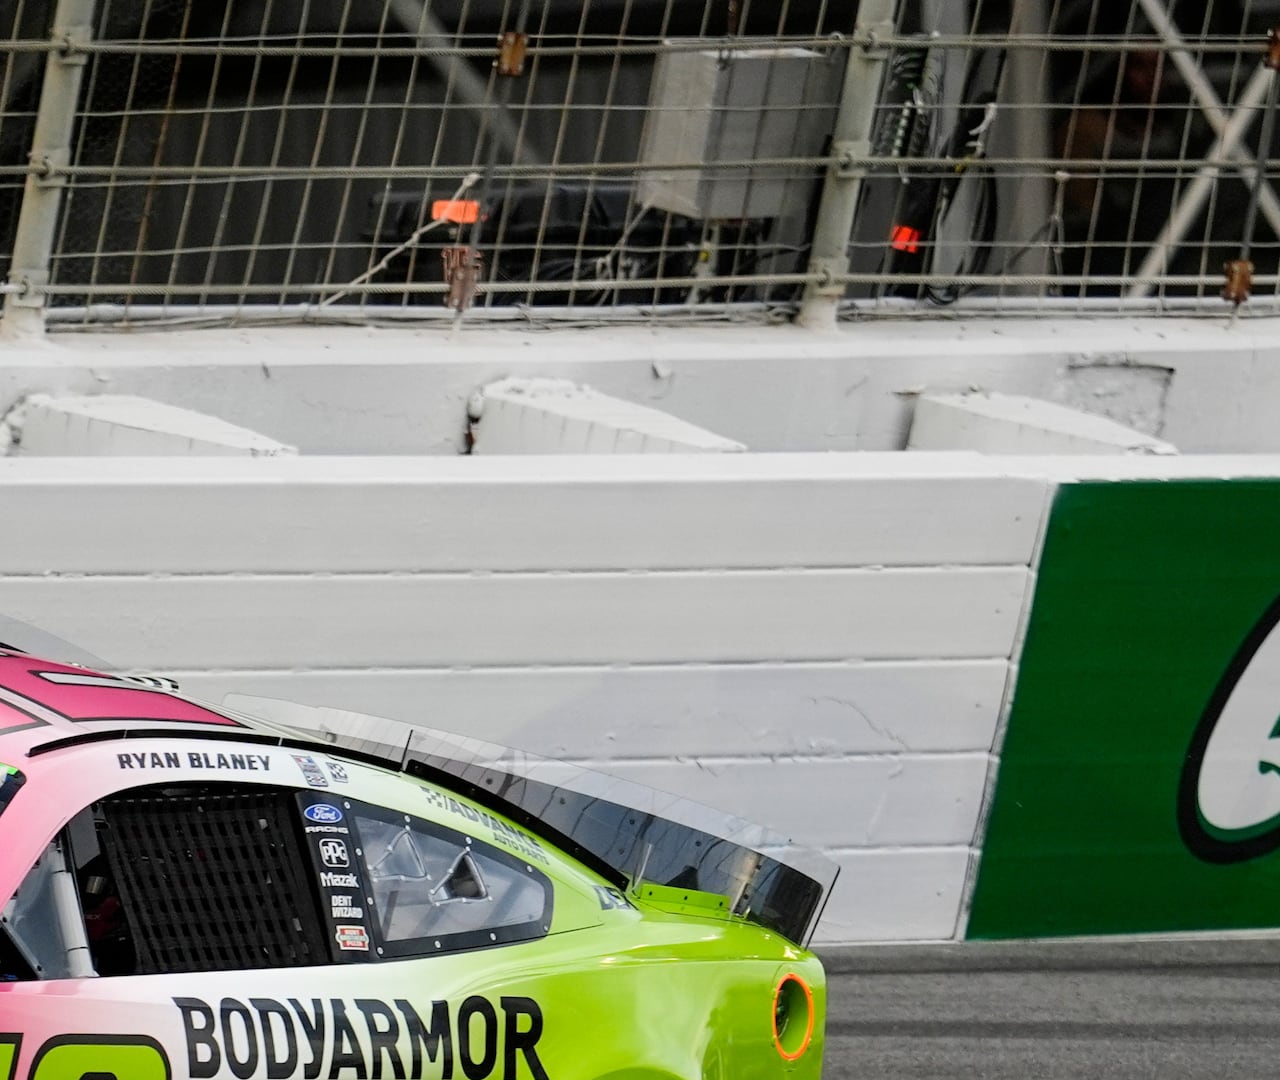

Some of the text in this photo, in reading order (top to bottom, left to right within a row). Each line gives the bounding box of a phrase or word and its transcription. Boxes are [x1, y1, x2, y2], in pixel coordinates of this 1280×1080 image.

[117, 752, 271, 771] RYAN BLANEY
[312, 805, 337, 822] Ford
[305, 826, 350, 834] RACING
[322, 842, 348, 864] PPG
[320, 872, 360, 888] Mazak
[331, 895, 353, 907] DENT
[331, 907, 363, 919] WIZARD
